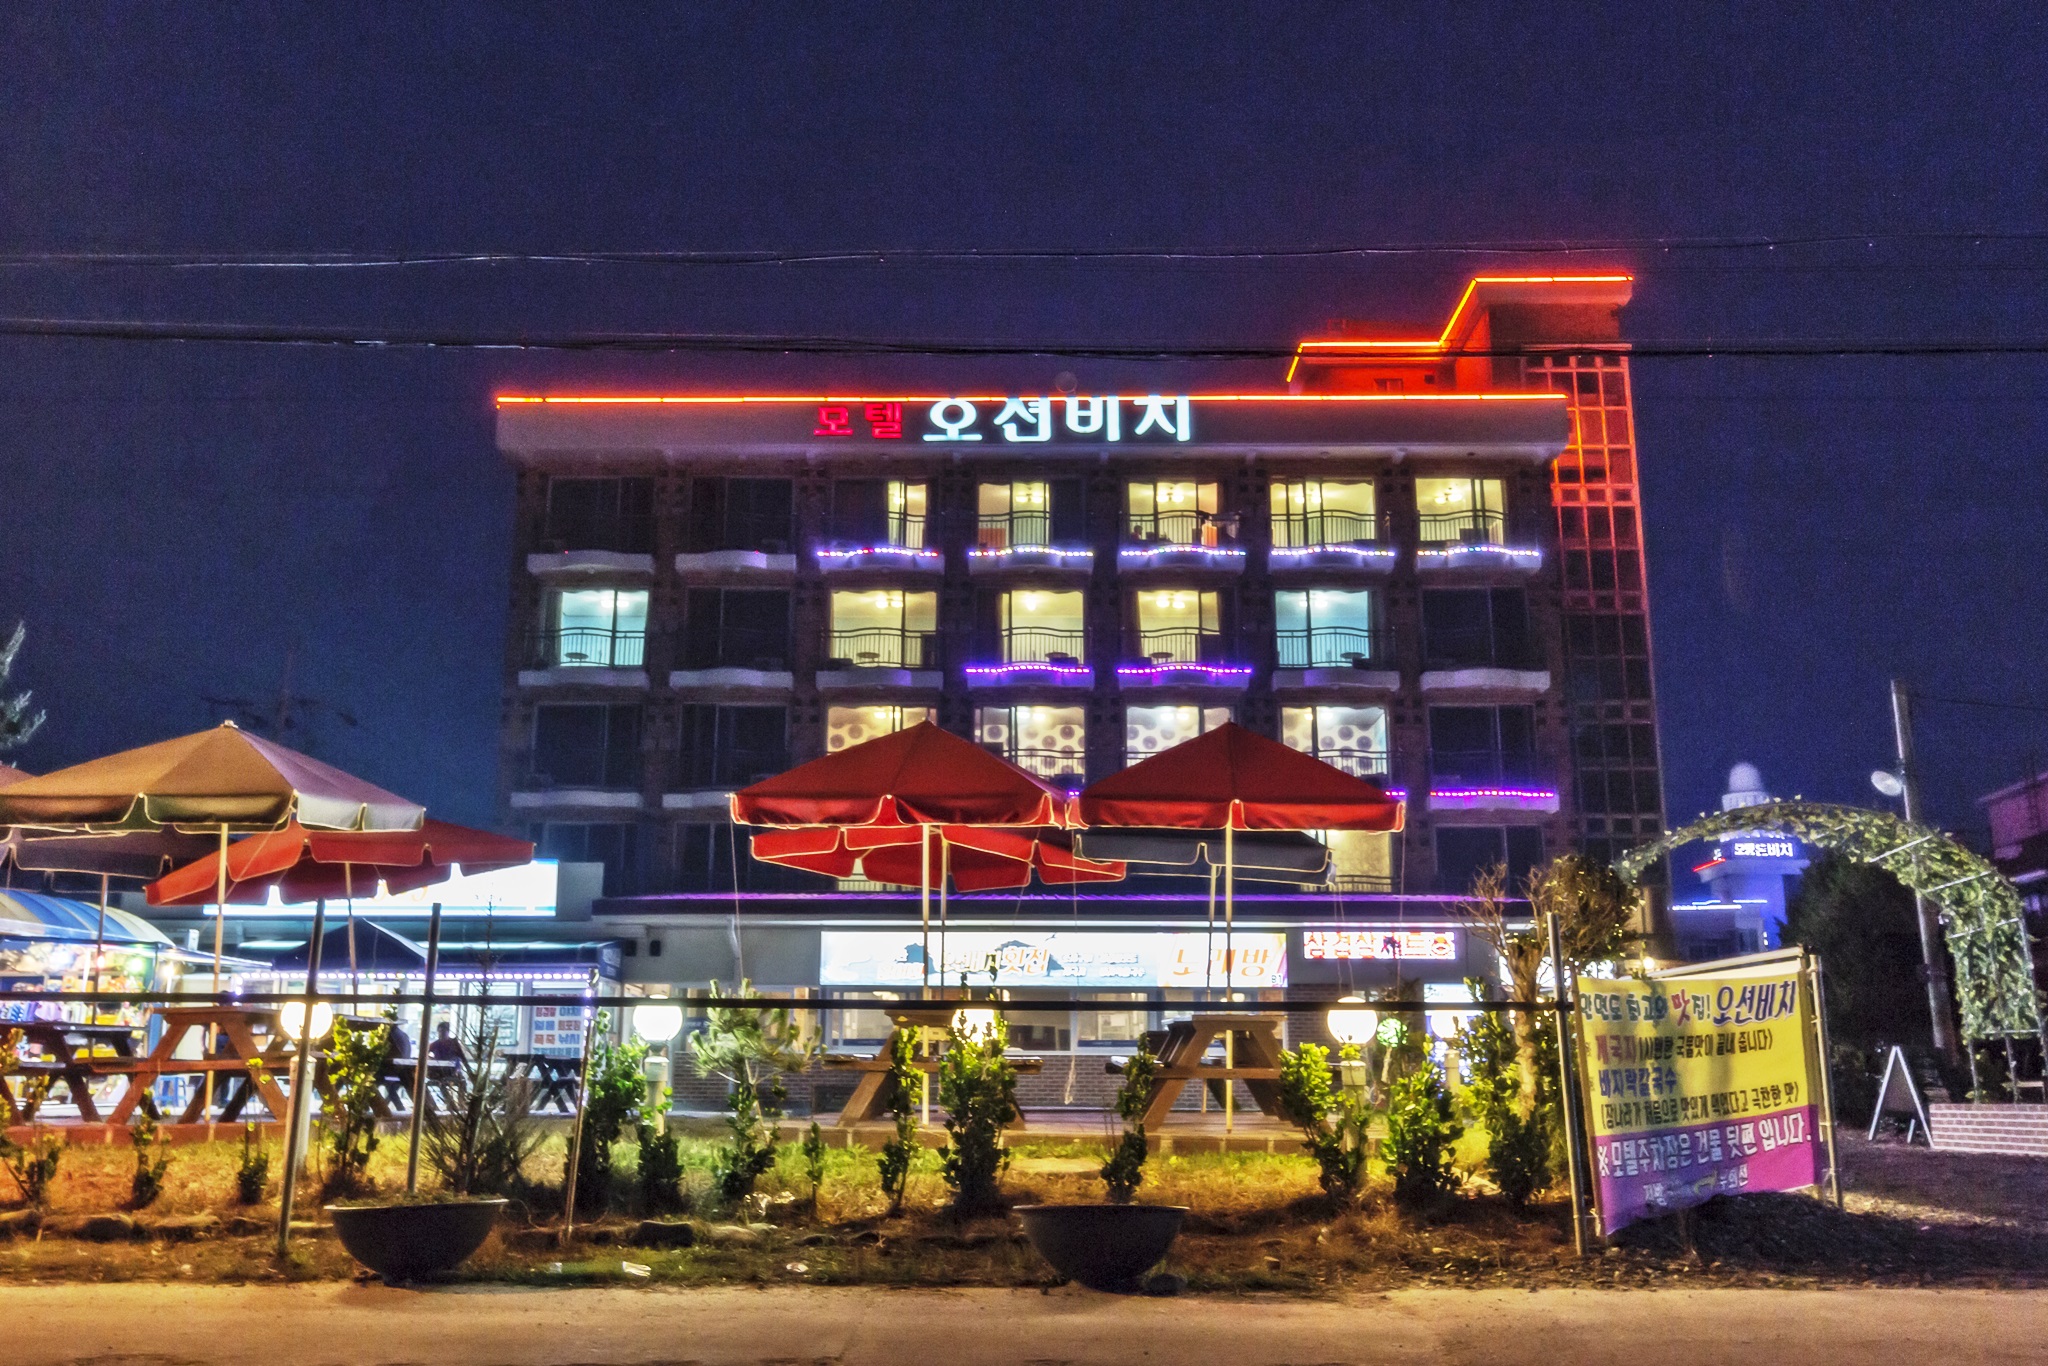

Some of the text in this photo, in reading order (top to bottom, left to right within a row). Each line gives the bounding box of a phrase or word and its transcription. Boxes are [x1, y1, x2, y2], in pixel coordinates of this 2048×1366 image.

[813, 396, 1191, 442] 모텔 오션비치
[1713, 980, 1797, 1026] 오션비치
